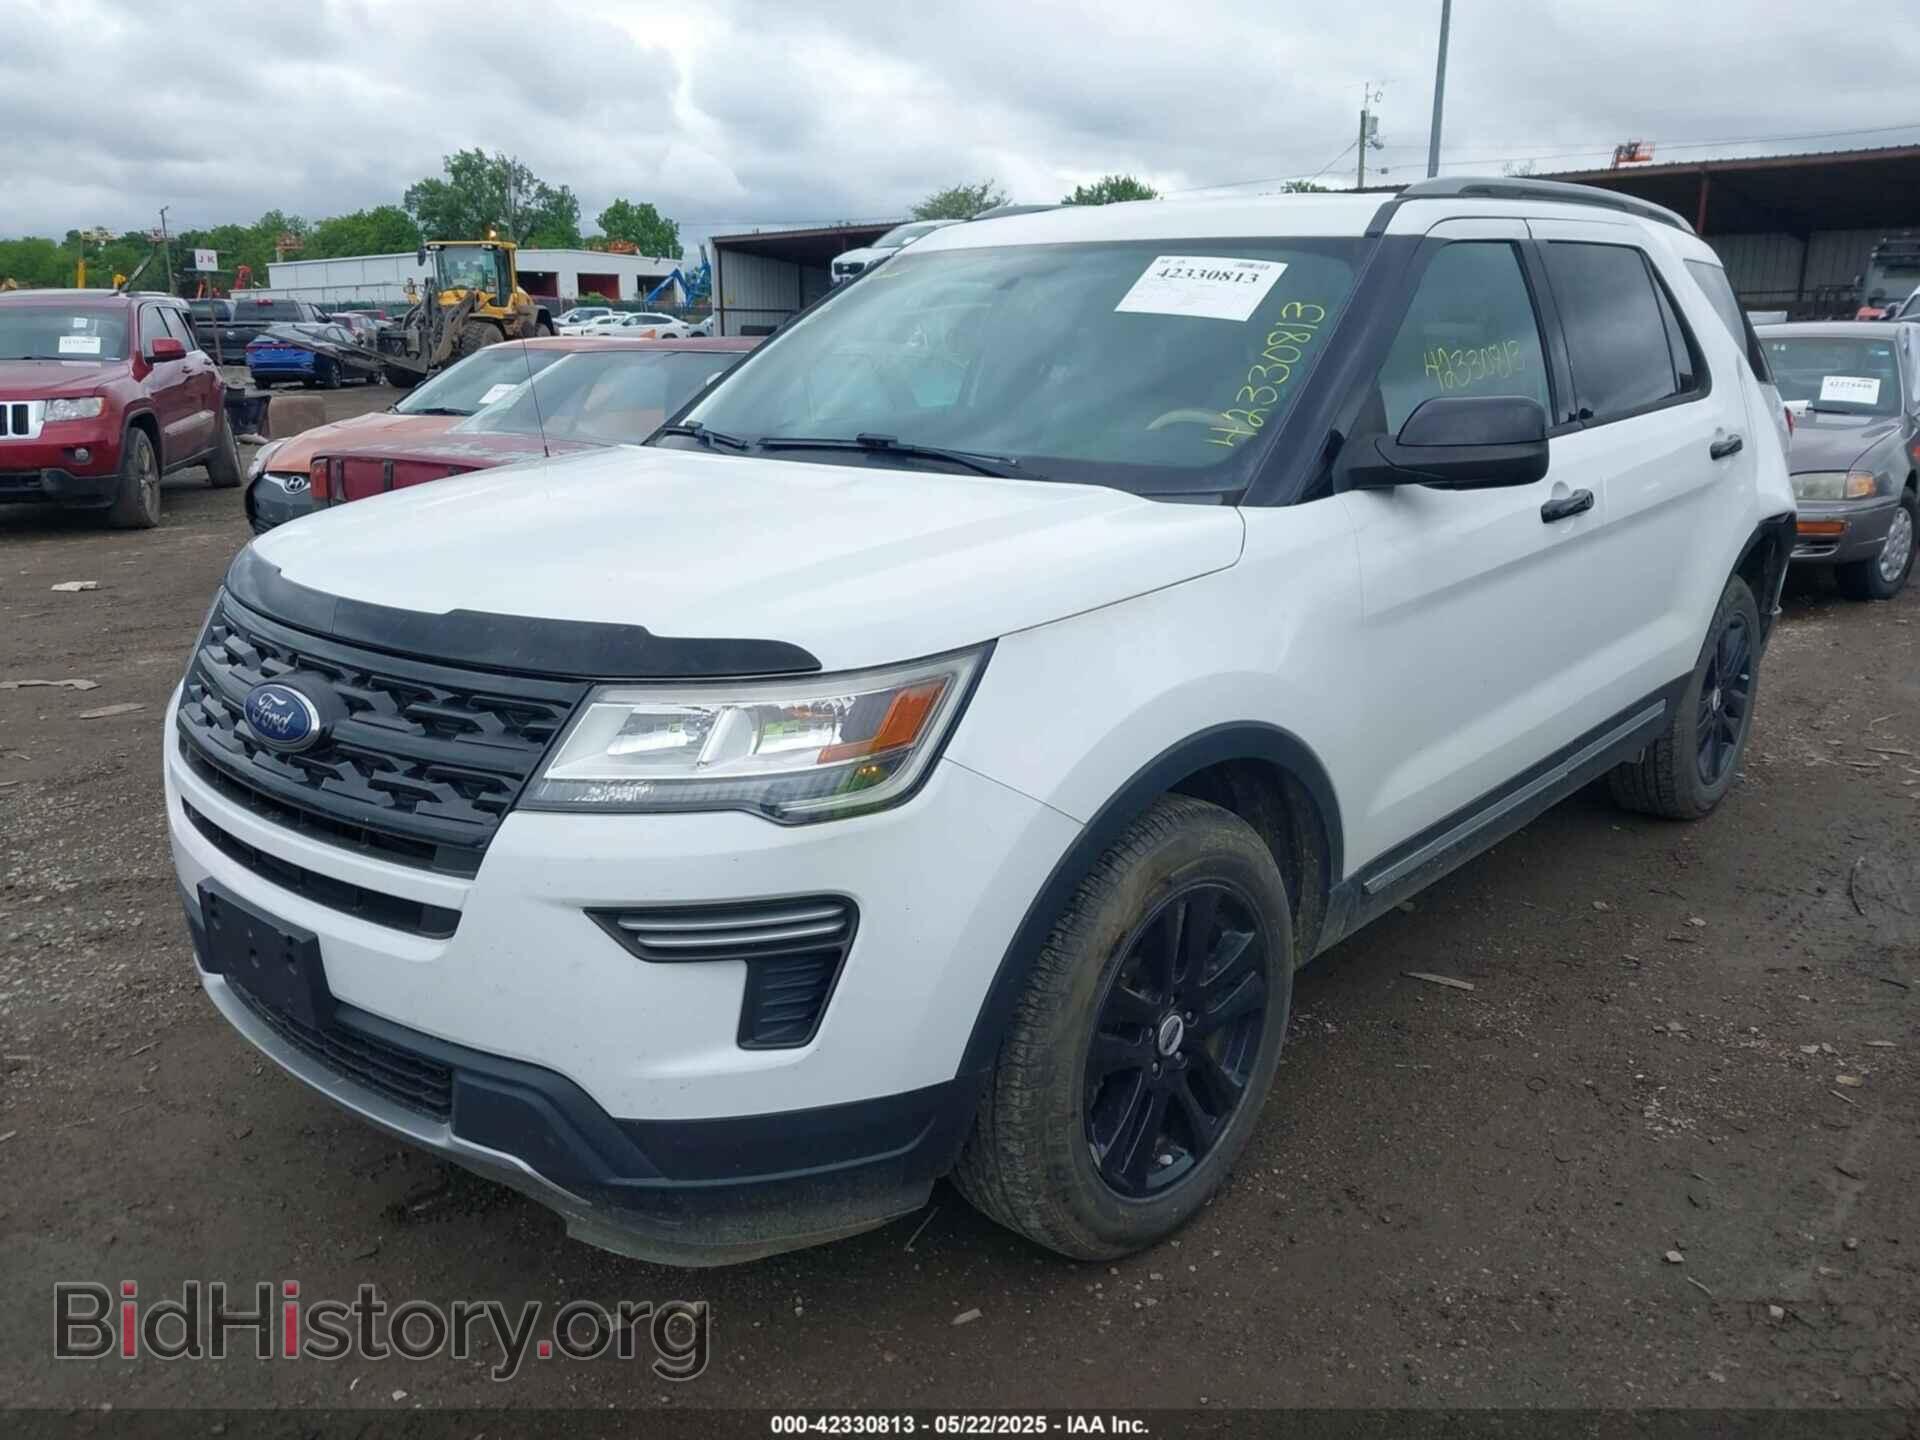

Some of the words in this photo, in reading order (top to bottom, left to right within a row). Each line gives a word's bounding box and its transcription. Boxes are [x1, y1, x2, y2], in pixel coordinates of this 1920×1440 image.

[1156, 266, 1260, 285] 42330813
[1204, 301, 1326, 448] 42330813
[252, 692, 295, 734] Ford
